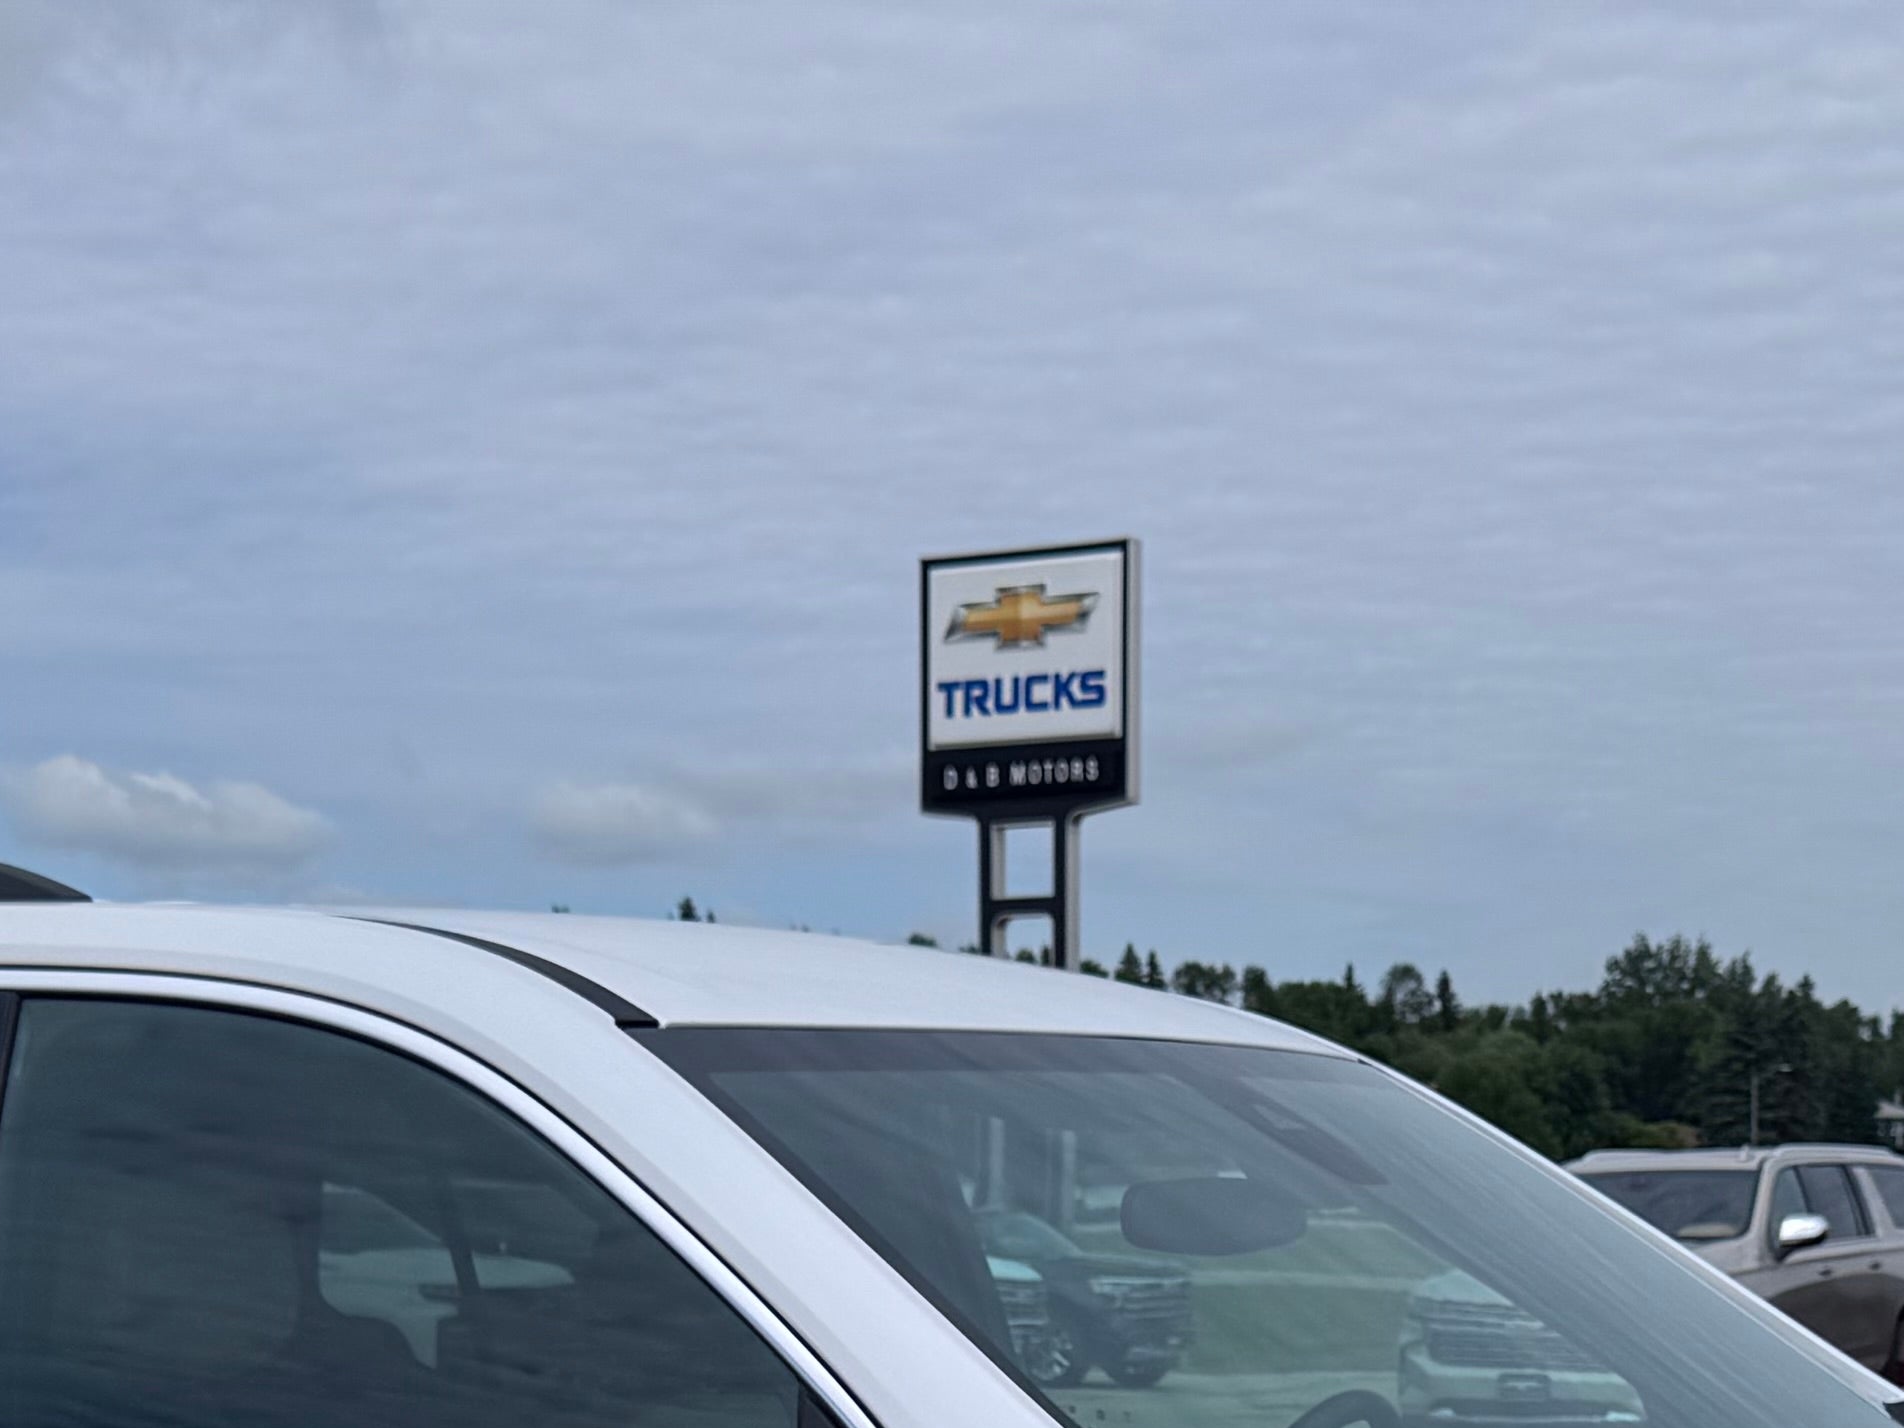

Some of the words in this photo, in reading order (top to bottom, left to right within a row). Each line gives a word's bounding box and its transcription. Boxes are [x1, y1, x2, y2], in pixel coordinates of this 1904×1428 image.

[937, 670, 1107, 719] TRUCKS
[943, 764, 958, 790] D
[1009, 756, 1099, 786] MOTORS
